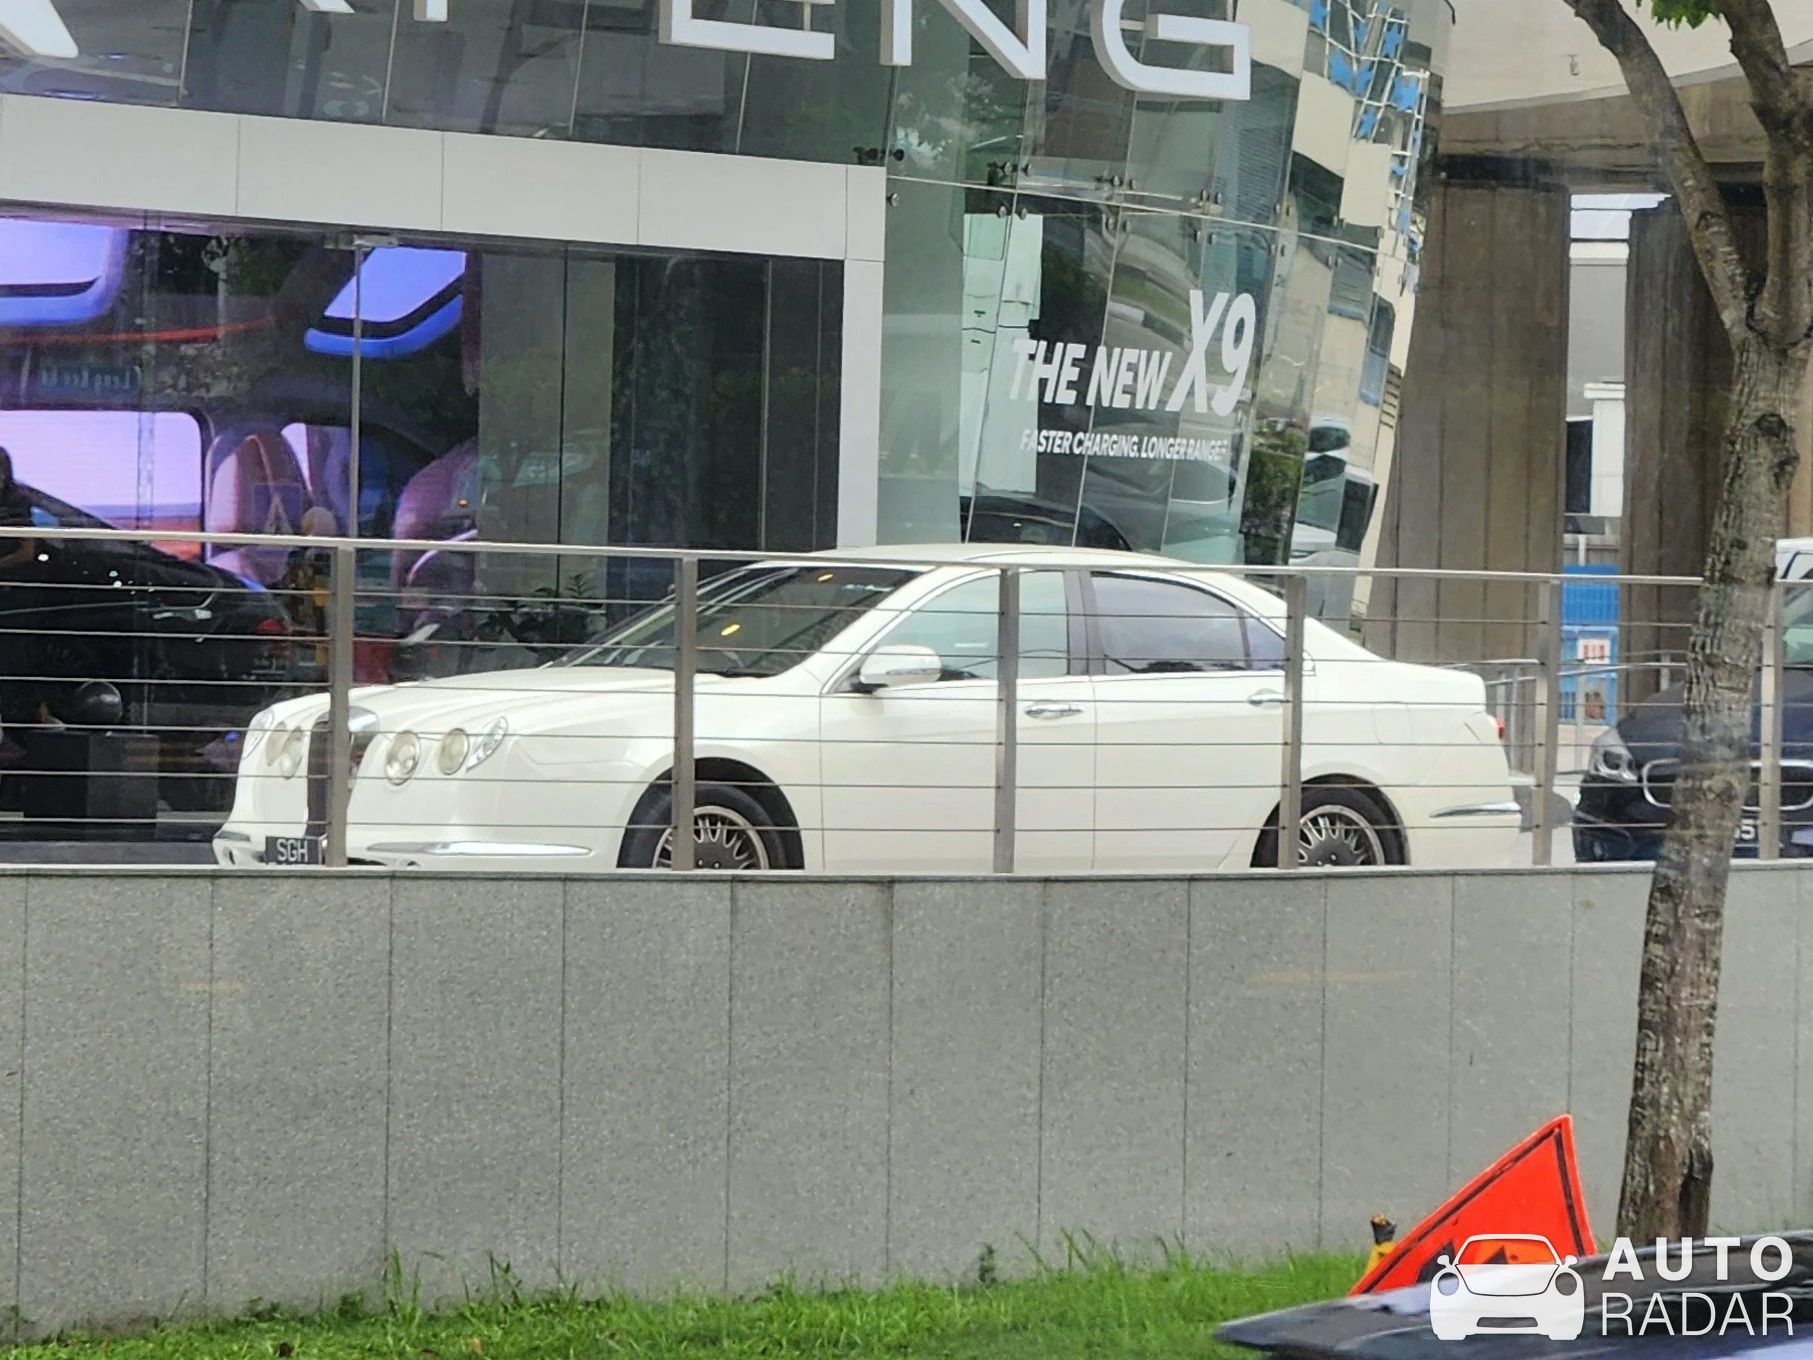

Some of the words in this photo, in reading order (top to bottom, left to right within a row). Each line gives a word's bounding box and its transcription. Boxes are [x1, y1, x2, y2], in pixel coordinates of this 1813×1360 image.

[1009, 338, 1087, 405] THE
[1085, 345, 1173, 410] NEW
[1165, 289, 1256, 416] X9
[1020, 429, 1073, 454] FASTER
[1072, 432, 1139, 458] CHARGING.
[1140, 436, 1187, 460] LONGER
[276, 838, 309, 863] SGH
